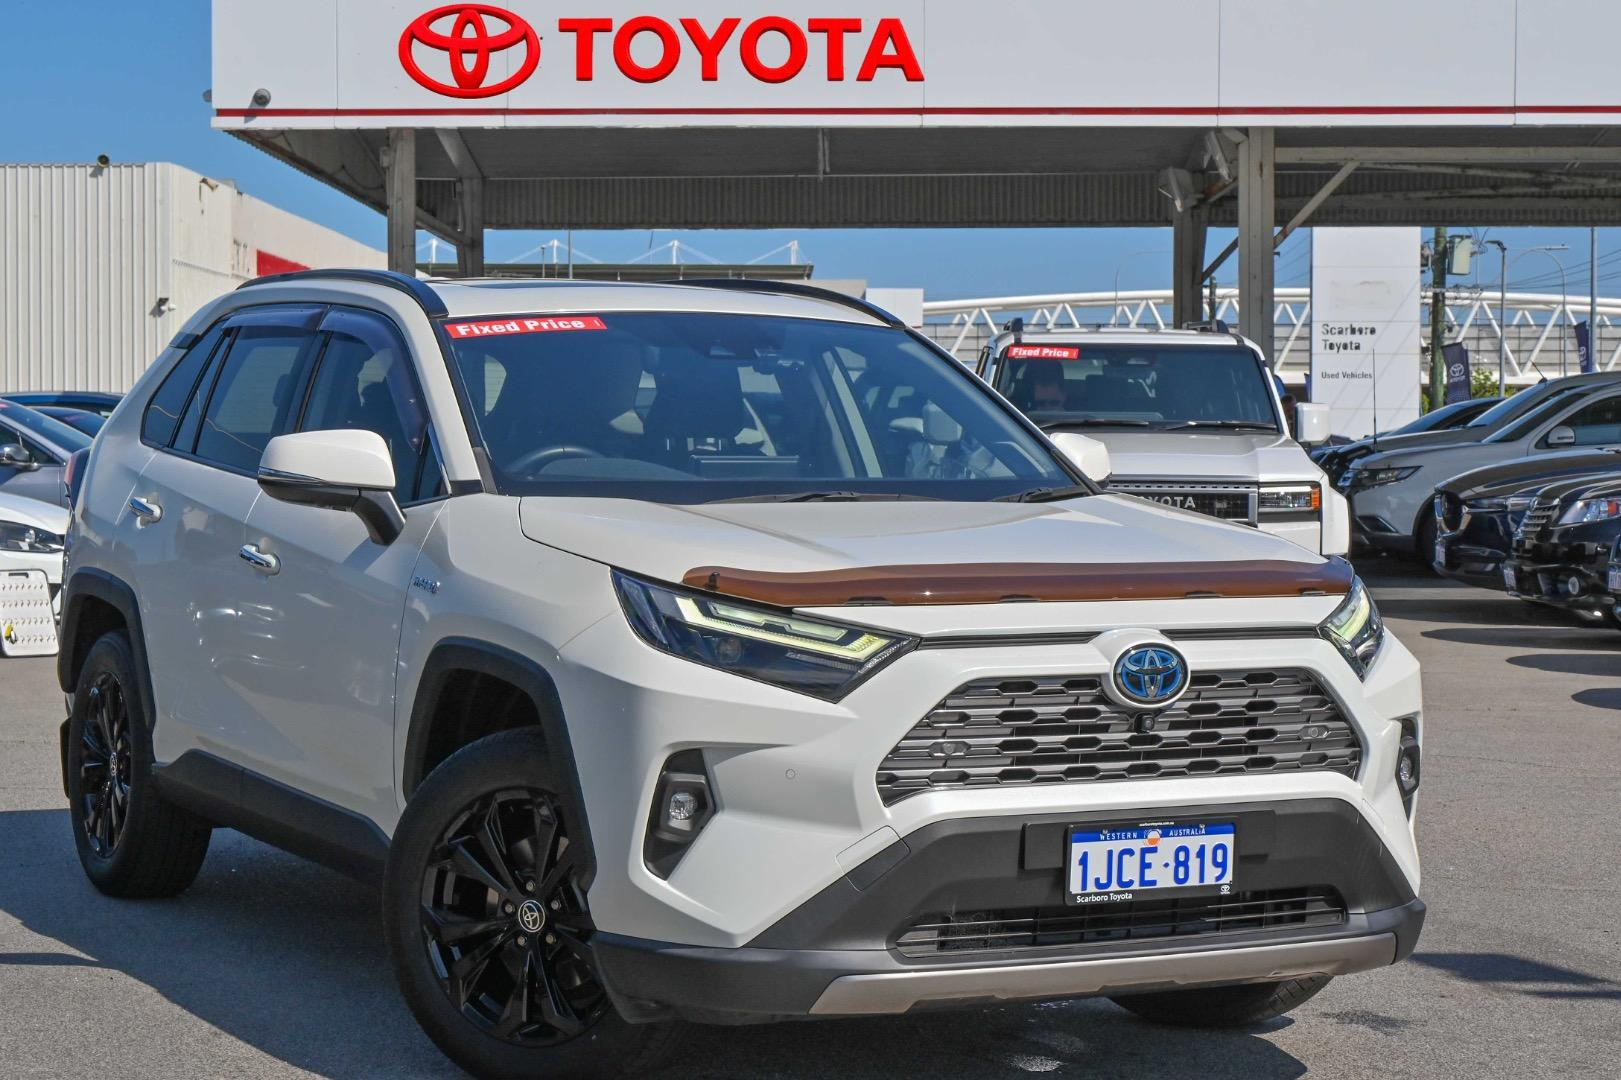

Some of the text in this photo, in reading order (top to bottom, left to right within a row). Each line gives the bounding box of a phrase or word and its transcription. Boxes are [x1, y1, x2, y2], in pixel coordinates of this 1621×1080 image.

[558, 16, 924, 83] TOYOTA
[456, 318, 586, 336] Fixed Price
[1321, 323, 1377, 336] Scarboro
[1012, 347, 1069, 357] Fixed Price
[1321, 339, 1361, 354] Toyota
[1321, 371, 1373, 379] Used Vehicles
[1099, 827, 1206, 841] WESTERN AUSTRALIA
[1076, 892, 1133, 904] Scarboro Toyota
